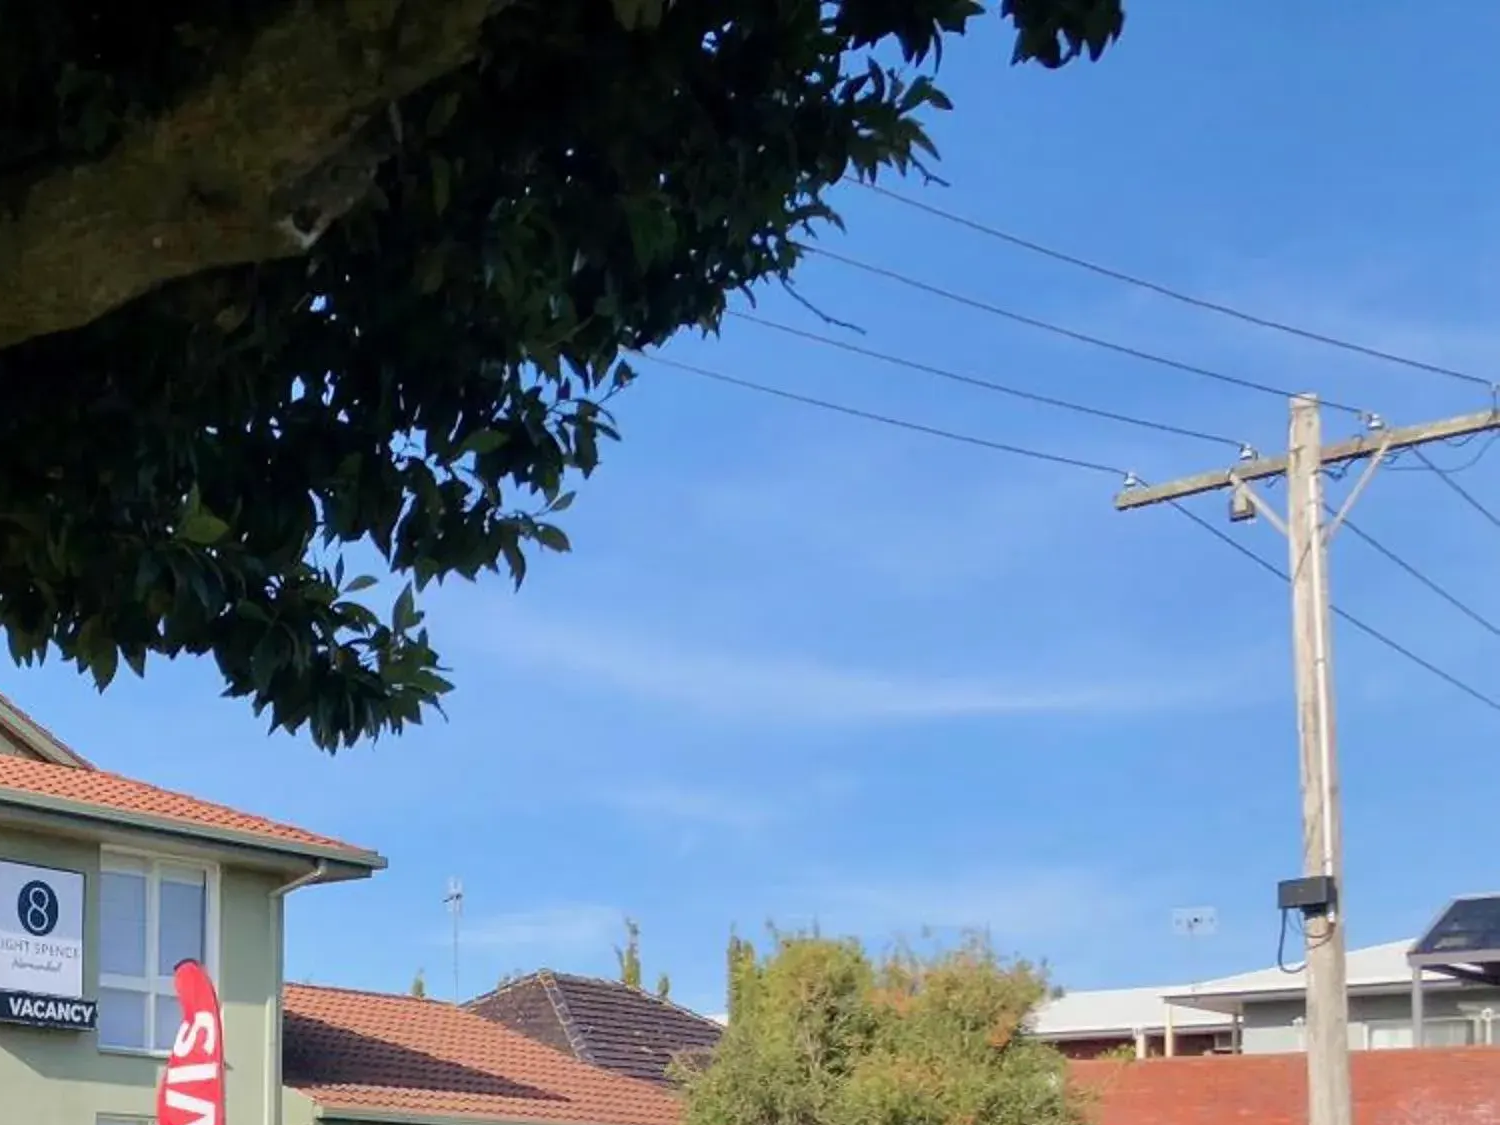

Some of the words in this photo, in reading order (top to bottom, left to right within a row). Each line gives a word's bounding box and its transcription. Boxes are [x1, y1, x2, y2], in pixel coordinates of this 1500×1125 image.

[27, 886, 50, 931] 8
[35, 942, 80, 959] SPENCE
[8, 997, 94, 1023] VACANCY
